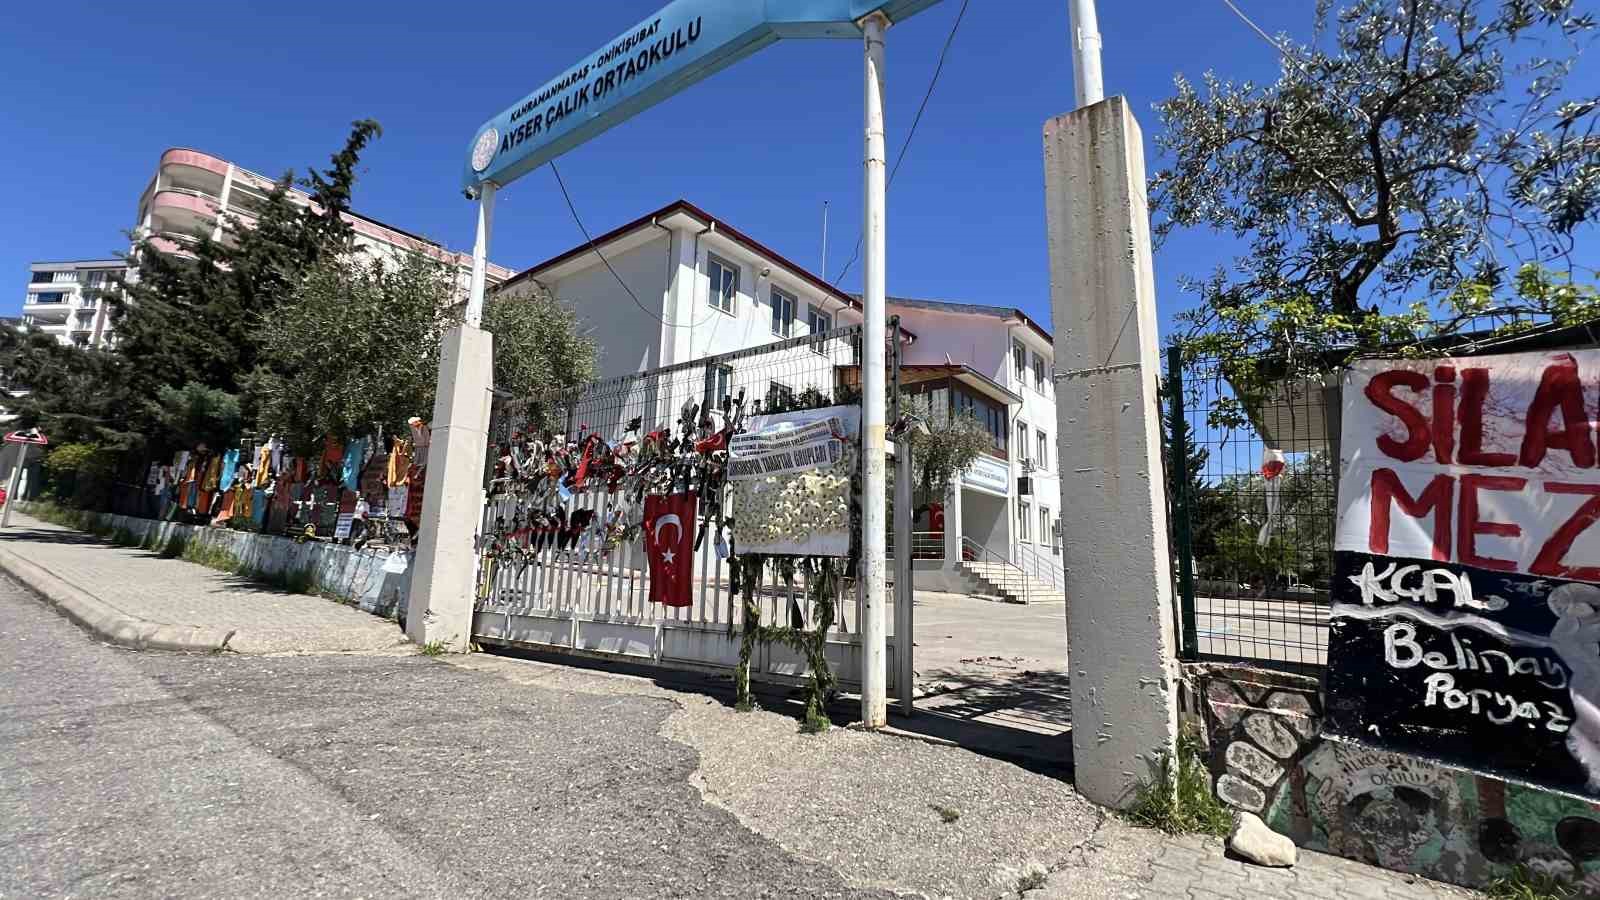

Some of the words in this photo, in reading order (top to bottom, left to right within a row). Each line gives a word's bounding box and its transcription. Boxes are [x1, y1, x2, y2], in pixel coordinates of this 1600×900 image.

[499, 115, 543, 155] AYSER
[545, 84, 590, 132] ÇALIK
[593, 16, 702, 98] ORTAOKULU
[509, 64, 590, 123] KAHRAMANMARAŞ
[597, 18, 662, 69] ONİKİŞUBAT
[1384, 623, 1570, 689] Belinay
